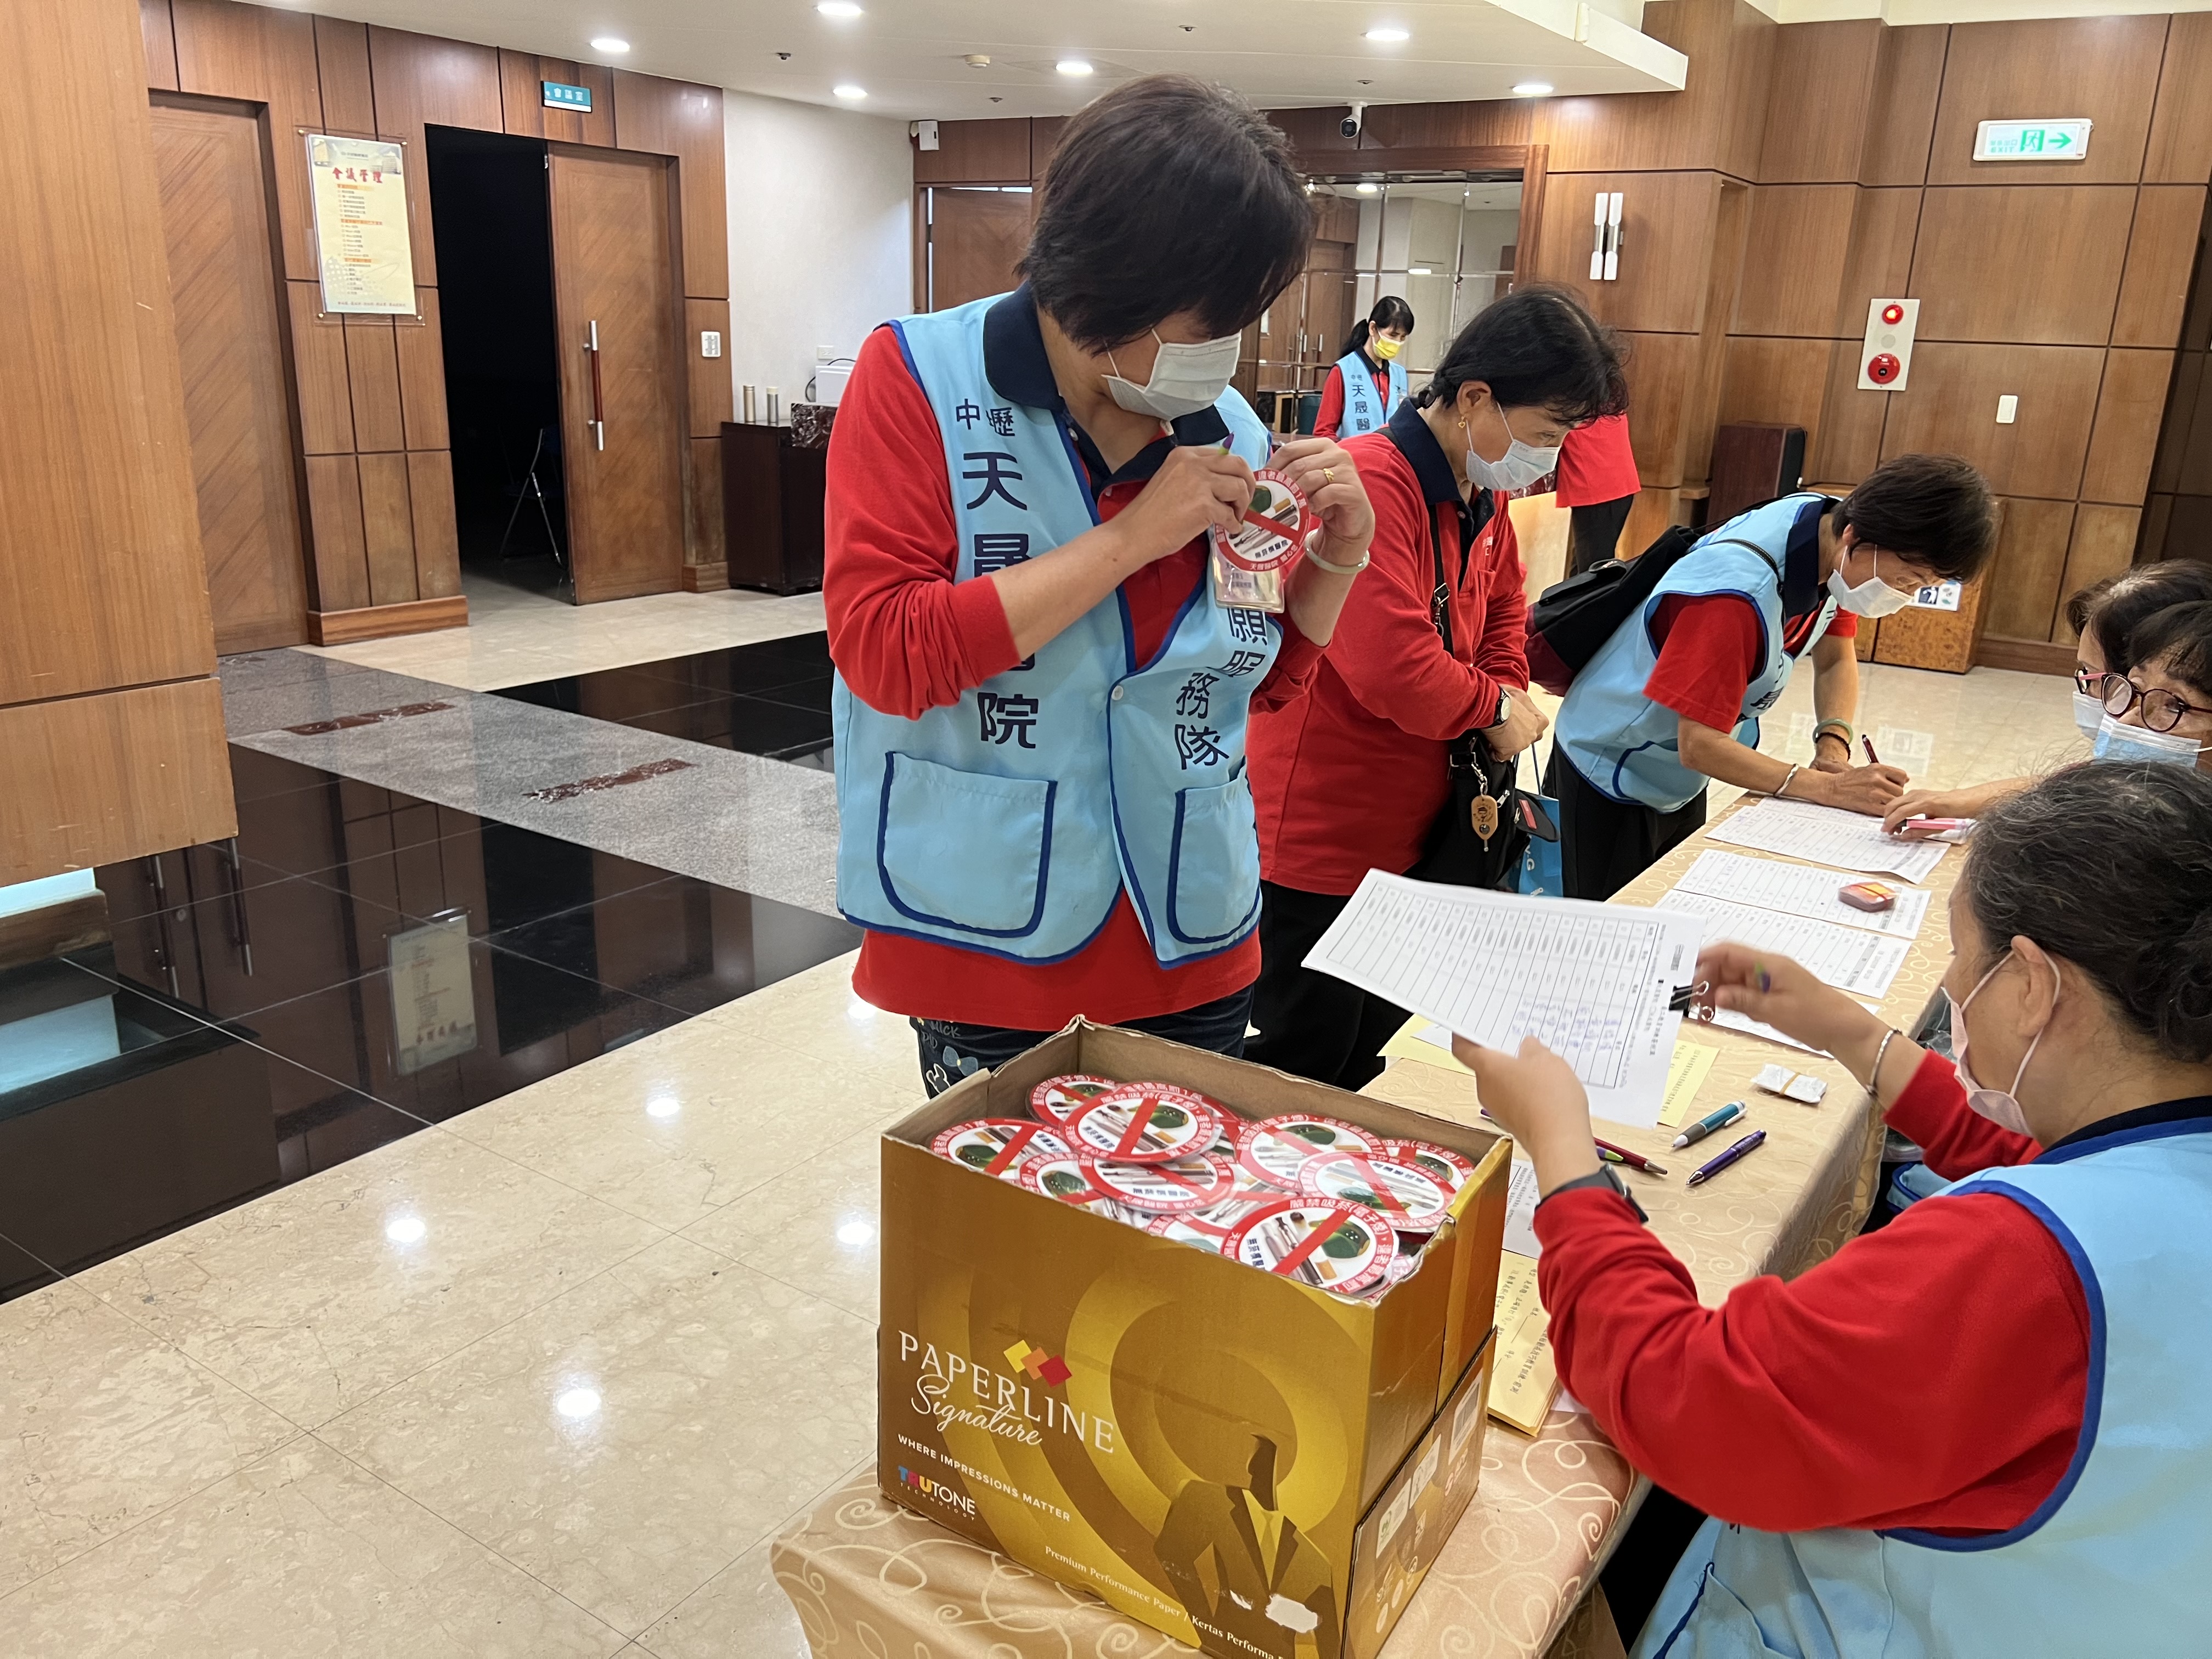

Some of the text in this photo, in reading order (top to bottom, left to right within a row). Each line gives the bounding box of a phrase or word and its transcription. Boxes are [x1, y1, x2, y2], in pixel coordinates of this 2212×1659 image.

[956, 398, 1015, 436] 中壢
[898, 1330, 1114, 1453] PAPERLINE
[911, 1374, 1043, 1446] Signature
[898, 1434, 1070, 1522] WHERE IMPRESSIONS MATTER
[898, 1465, 975, 1515] TRUTONE
[900, 1482, 975, 1520] TECHNOLOGY
[1045, 1545, 1087, 1573] Premium
[1090, 1567, 1151, 1603] Performance
[1153, 1596, 1181, 1617] Paper
[1192, 1615, 1223, 1638] Kertas
[1227, 1632, 1274, 1659] Performa
